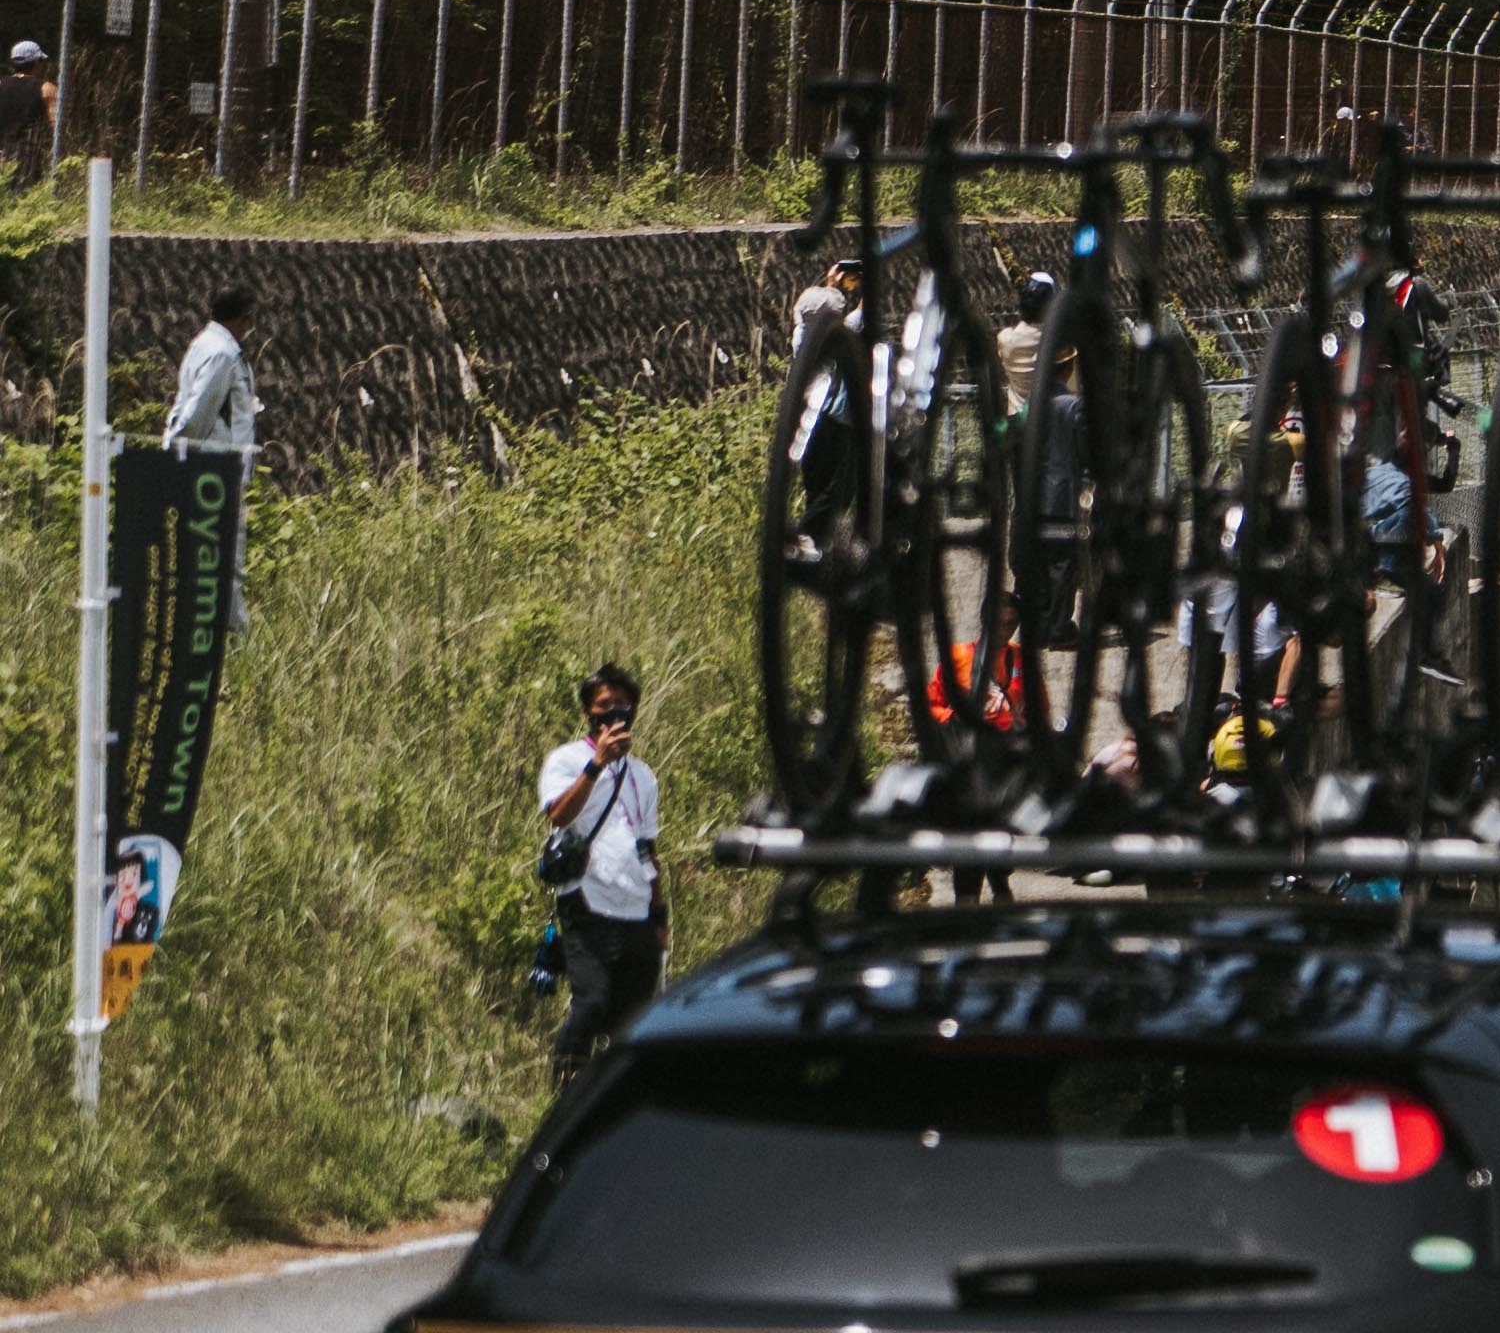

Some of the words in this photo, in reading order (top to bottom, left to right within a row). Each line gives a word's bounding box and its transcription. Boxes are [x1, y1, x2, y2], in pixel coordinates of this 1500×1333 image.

[187, 471, 227, 656] Oyama
[160, 672, 209, 815] Town
[1323, 1093, 1401, 1173] 1
